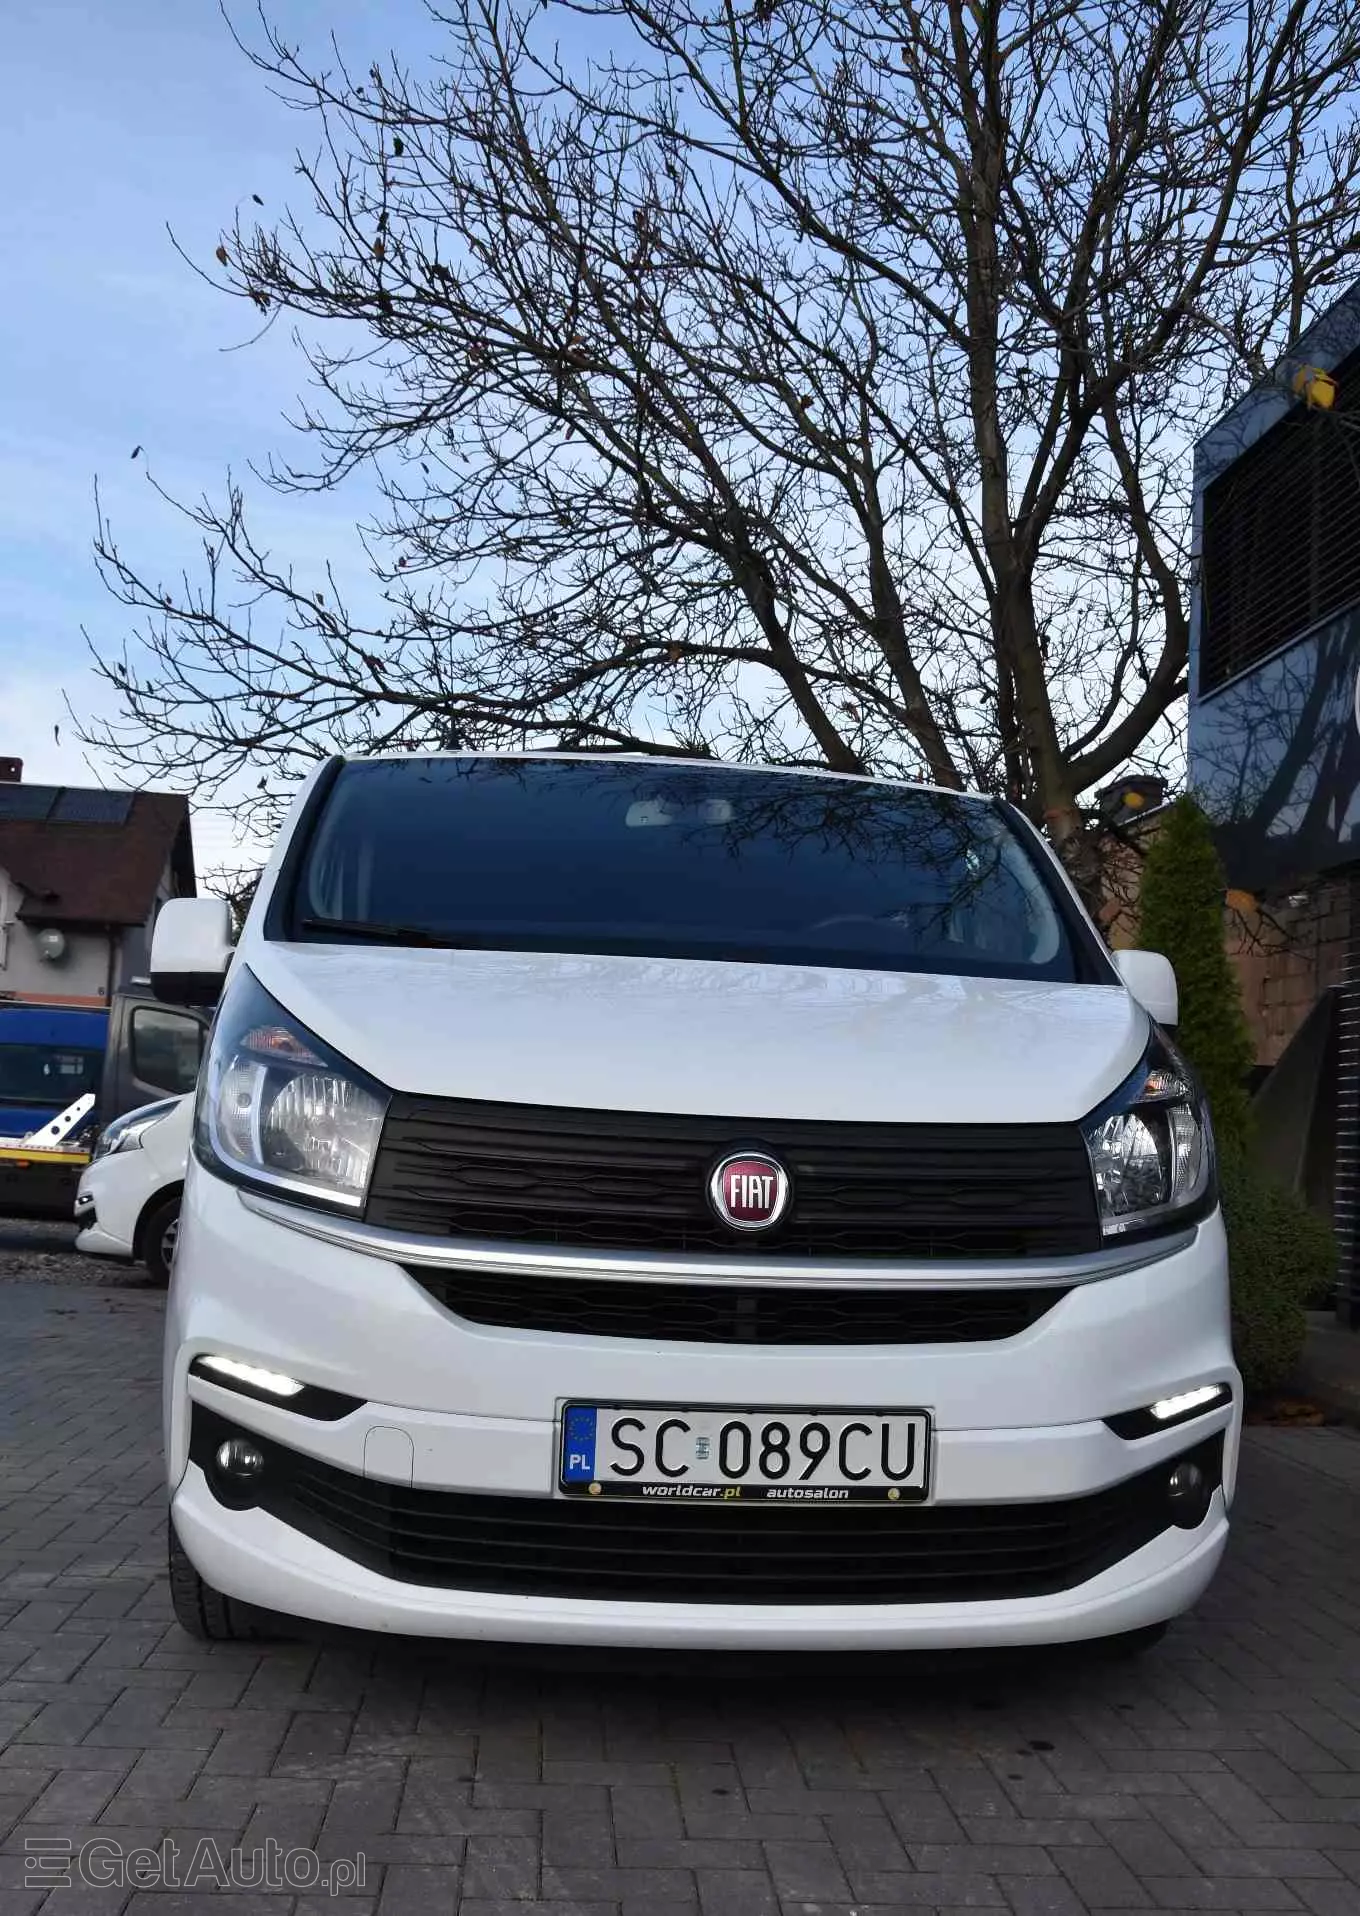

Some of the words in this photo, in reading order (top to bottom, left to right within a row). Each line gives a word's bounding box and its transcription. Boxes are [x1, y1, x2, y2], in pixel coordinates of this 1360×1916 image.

[730, 1175, 774, 1209] FIAT
[610, 1417, 692, 1477] SC
[718, 1421, 915, 1481] 089CU
[569, 1454, 591, 1470] PL
[641, 1484, 741, 1498] worldcar.pl
[766, 1487, 849, 1499] autosalon
